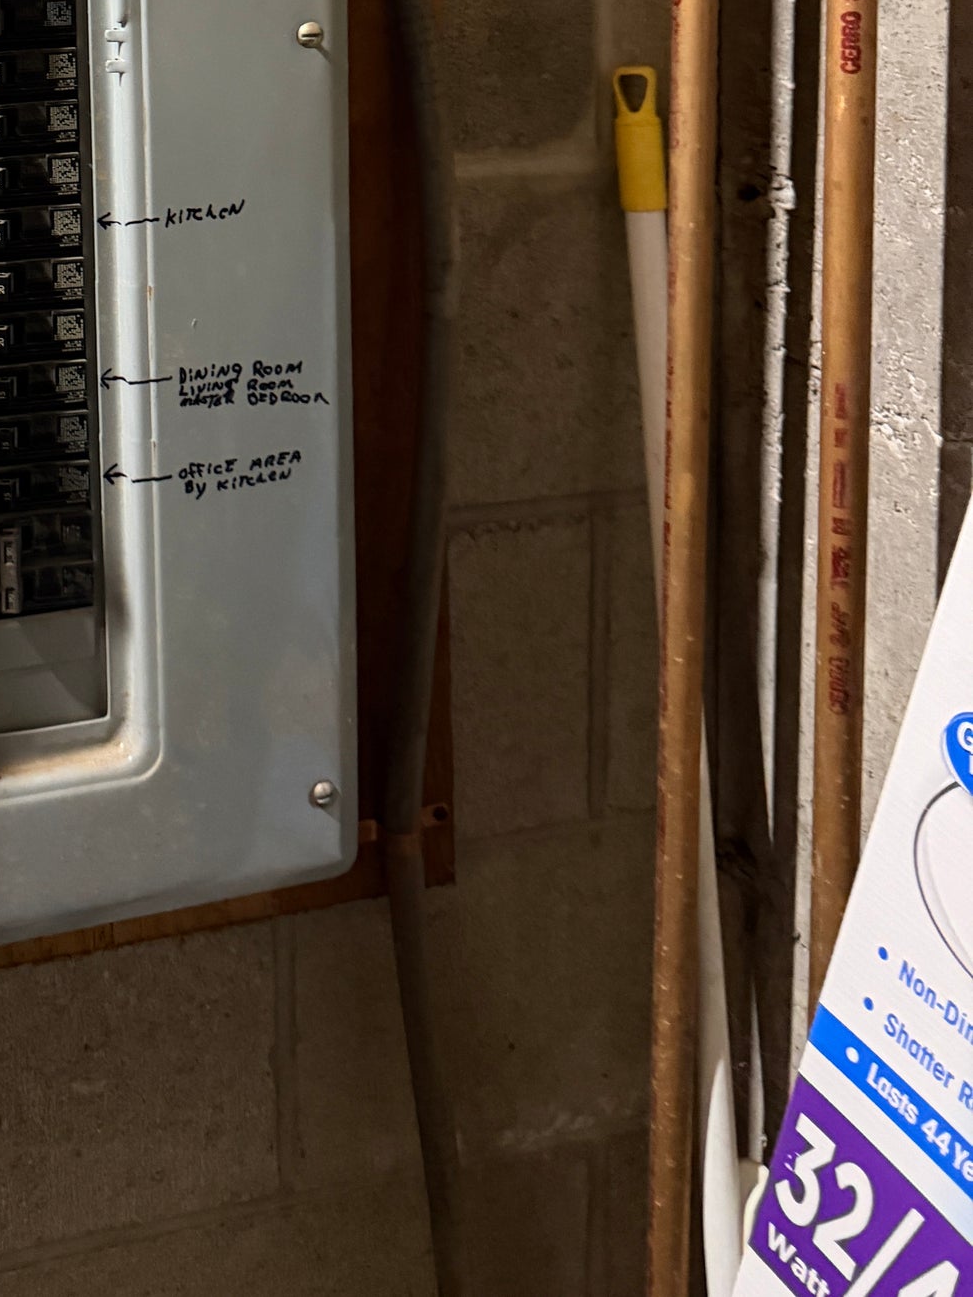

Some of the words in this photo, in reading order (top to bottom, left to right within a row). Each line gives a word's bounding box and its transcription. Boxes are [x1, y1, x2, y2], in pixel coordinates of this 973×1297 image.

[840, 11, 862, 75] CERRO
[247, 378, 294, 391] ROOM
[252, 360, 303, 378] ROOM
[178, 458, 238, 480] OFFICE
[249, 450, 302, 471] AREA
[884, 1013, 955, 1089] Shatter
[866, 1062, 919, 1126] Lasts
[921, 1118, 952, 1157] 44
